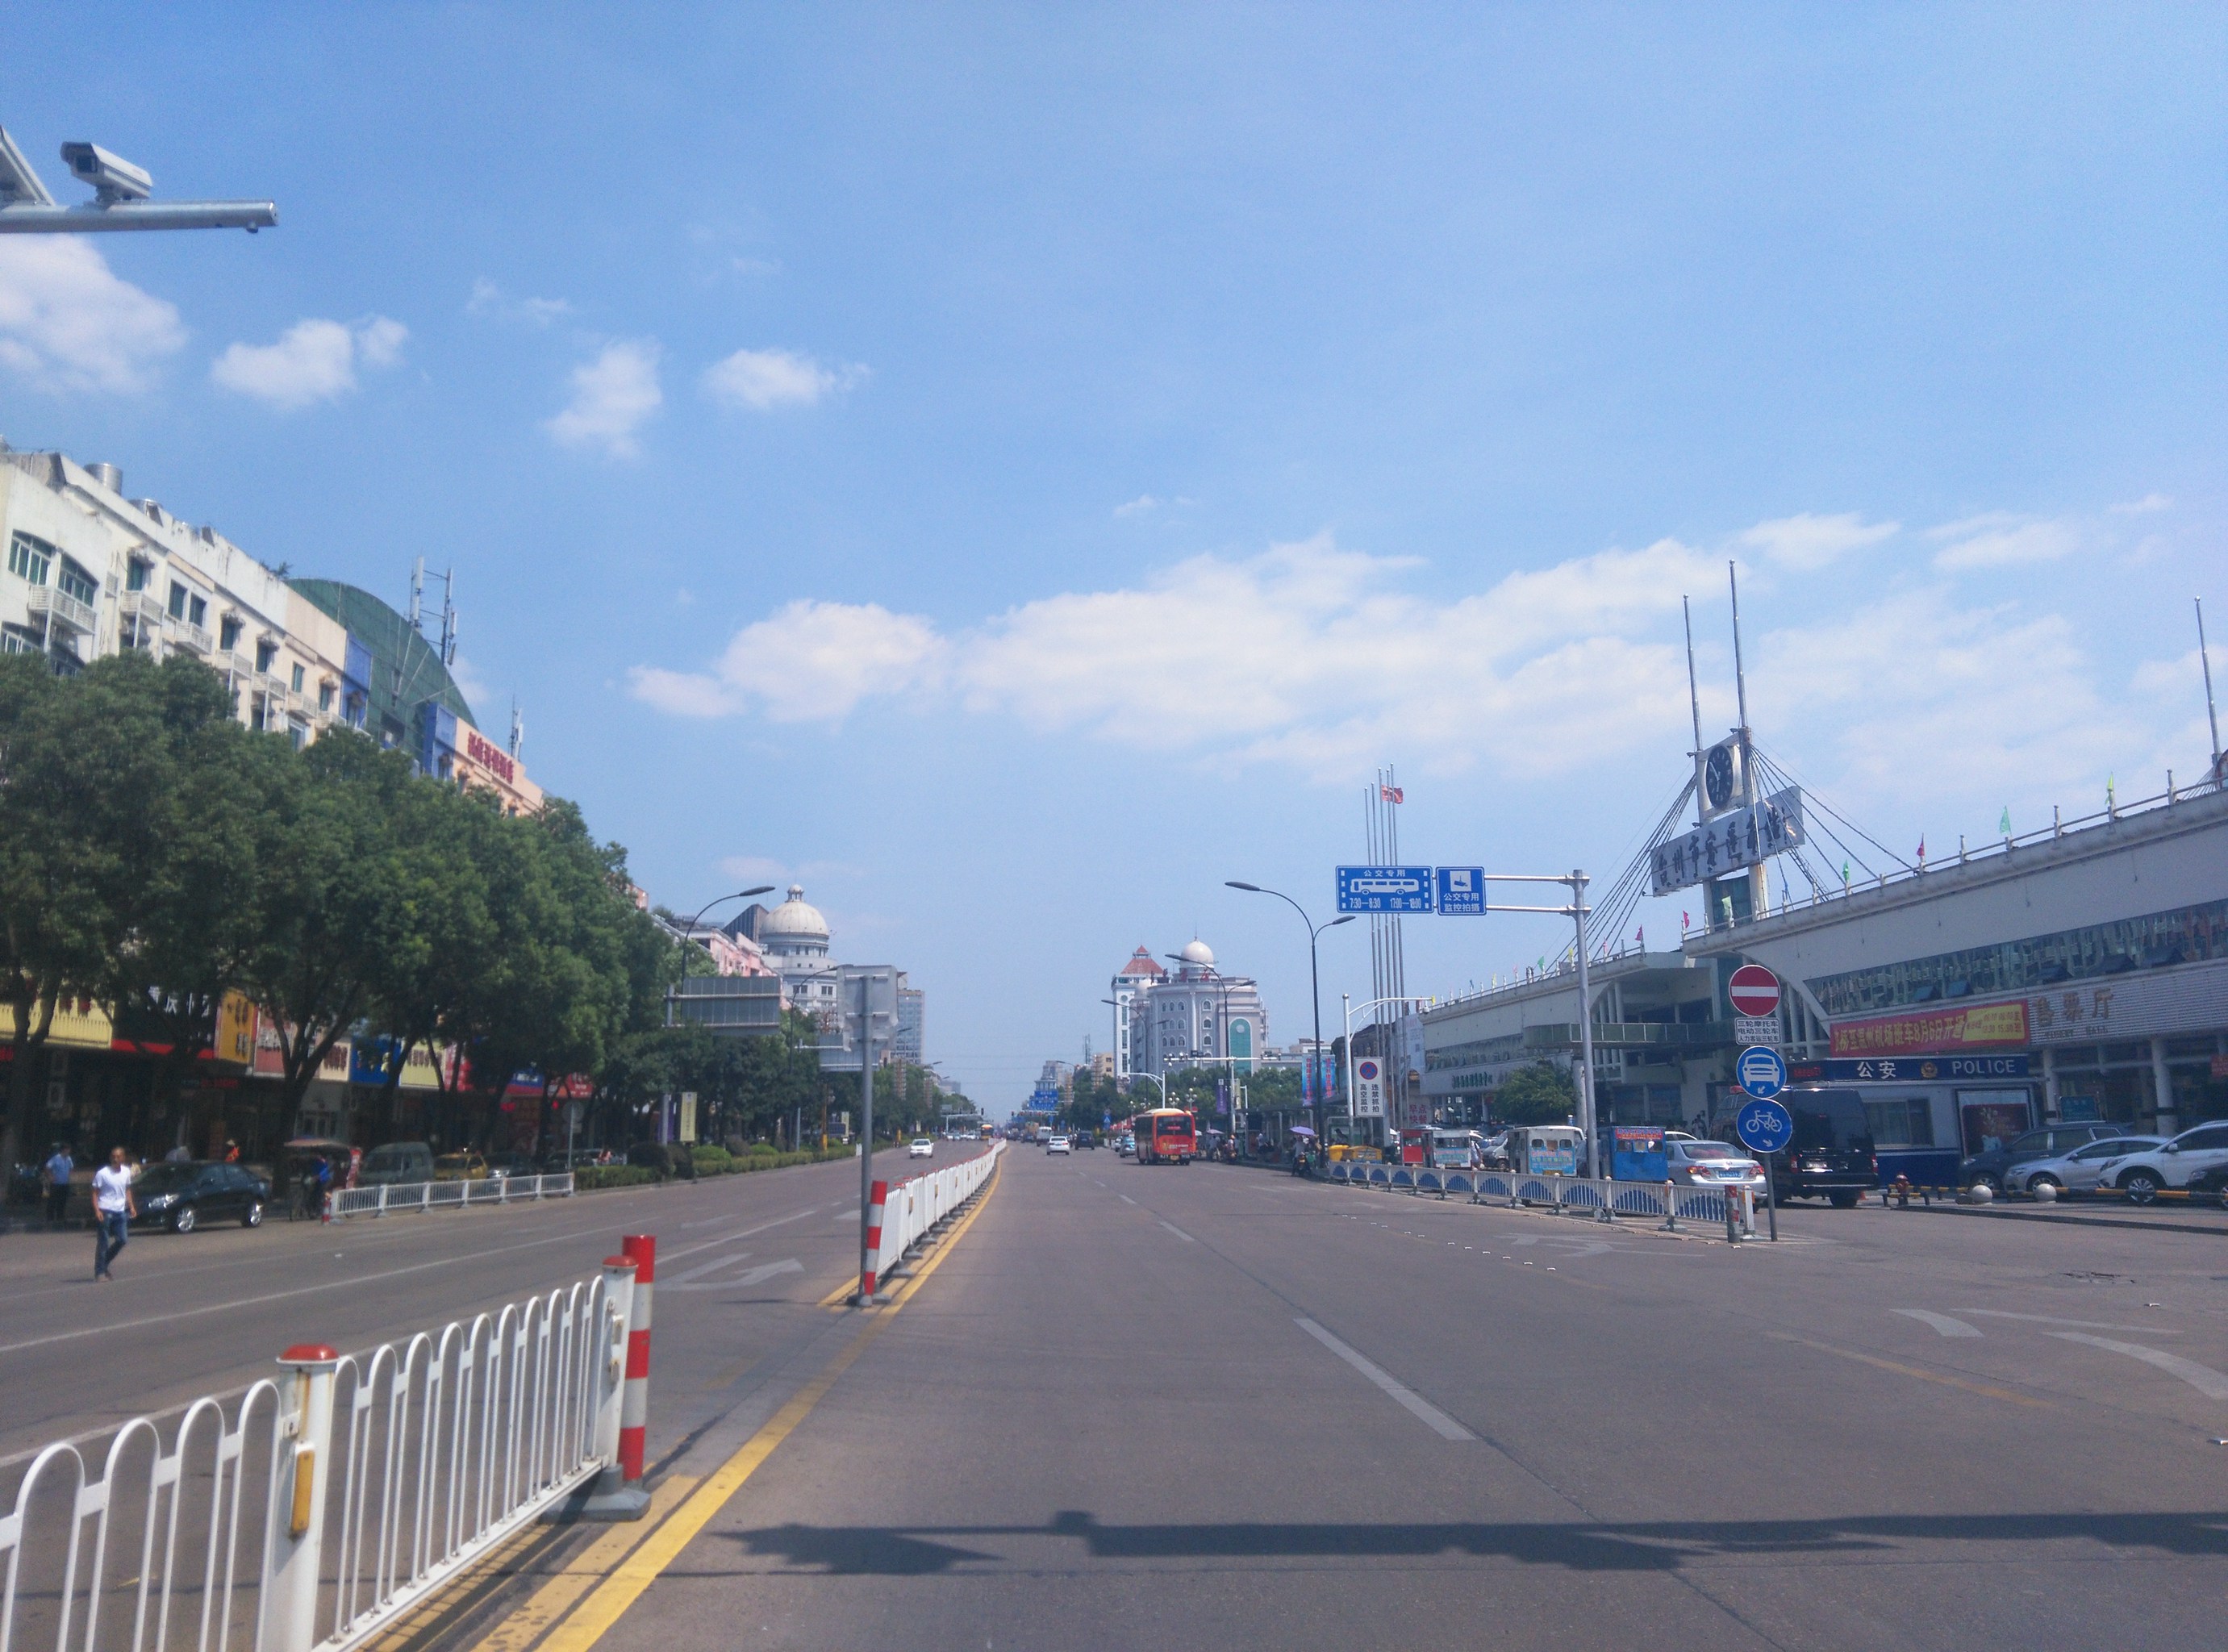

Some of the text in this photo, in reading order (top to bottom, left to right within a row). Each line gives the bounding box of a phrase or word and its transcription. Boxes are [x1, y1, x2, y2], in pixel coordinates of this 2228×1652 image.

[1363, 869, 1406, 878] 公交专用
[1444, 892, 1479, 902] 公交专用
[1444, 903, 1480, 912] 监控拍摄
[2032, 987, 2114, 1027] 售票厅
[1856, 1061, 1896, 1079] 公安
[1952, 1059, 2016, 1074] POLICE
[1359, 1083, 1369, 1113] 高空监控
[1371, 1083, 1380, 1113] 违禁抓拍
